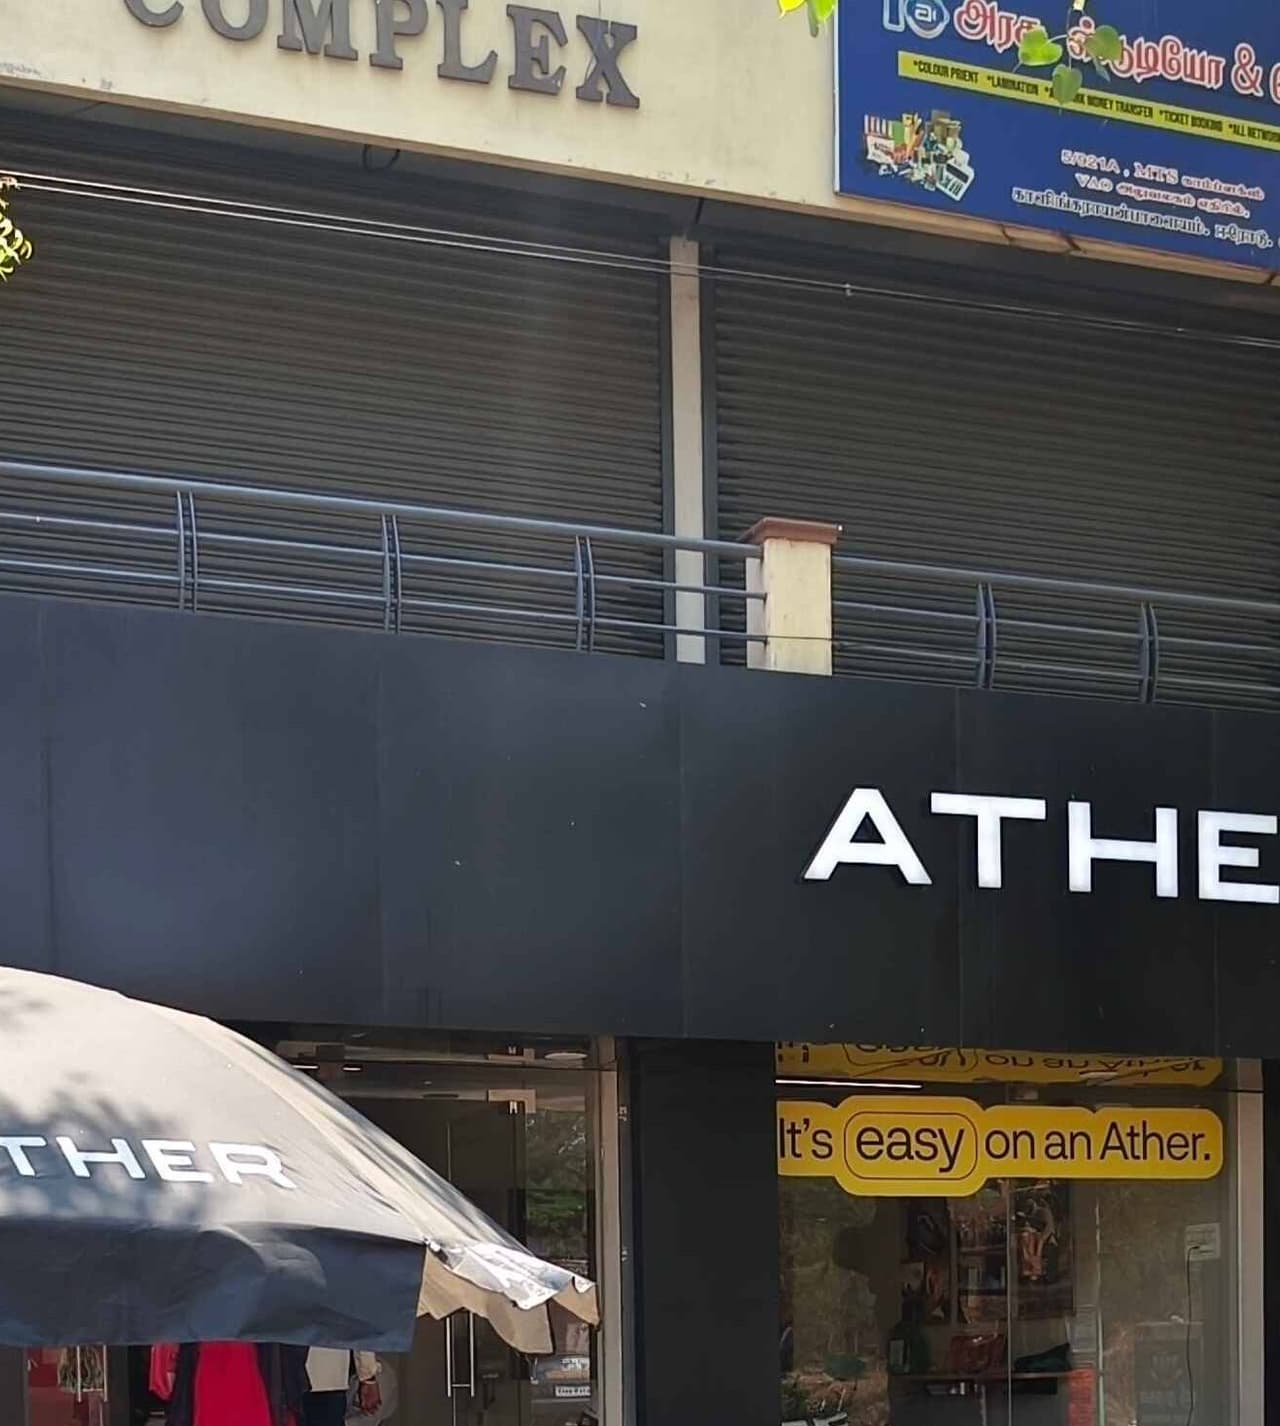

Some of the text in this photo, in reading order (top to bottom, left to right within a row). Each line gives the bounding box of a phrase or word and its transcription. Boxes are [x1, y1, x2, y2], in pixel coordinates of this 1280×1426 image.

[1231, 42, 1264, 97] &
[1133, 161, 1180, 187] MTS
[776, 1112, 1212, 1174] It's easy on an Ather.
